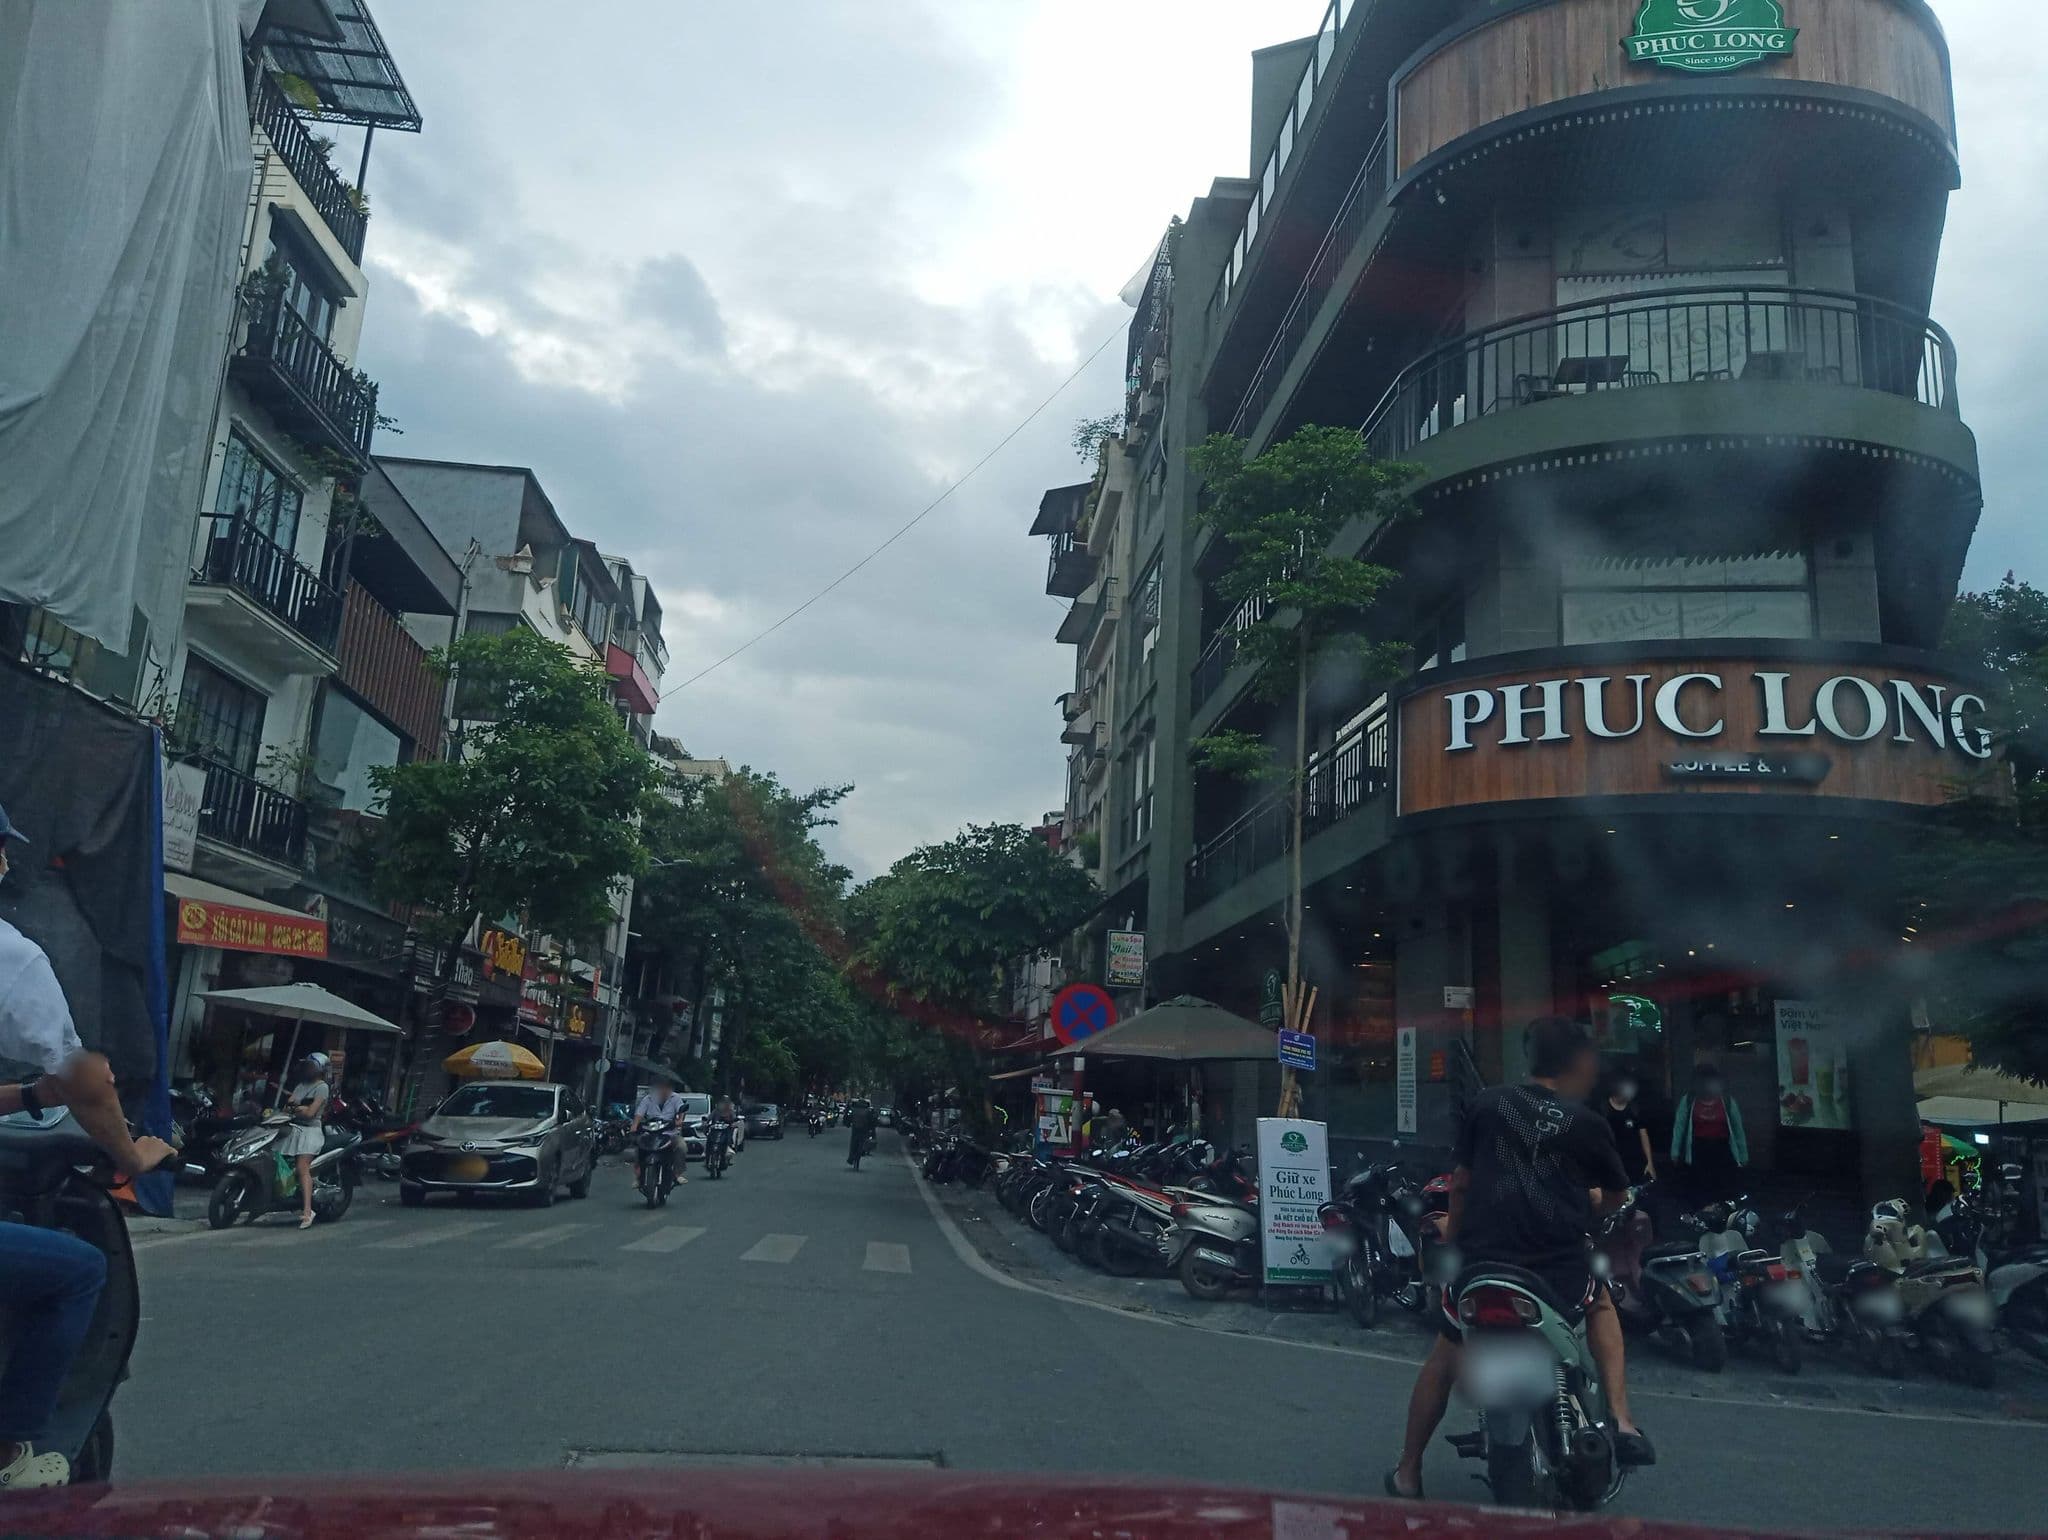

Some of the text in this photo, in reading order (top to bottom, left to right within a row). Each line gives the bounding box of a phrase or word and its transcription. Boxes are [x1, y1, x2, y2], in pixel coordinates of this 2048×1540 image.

[1634, 33, 1786, 55] PHUC LONG
[1685, 55, 1736, 64] Since 1968
[1444, 671, 1993, 760] PHUC LONG
[1276, 1170, 1316, 1185] Giữ xe
[1270, 1185, 1324, 1203] Phúc Long
